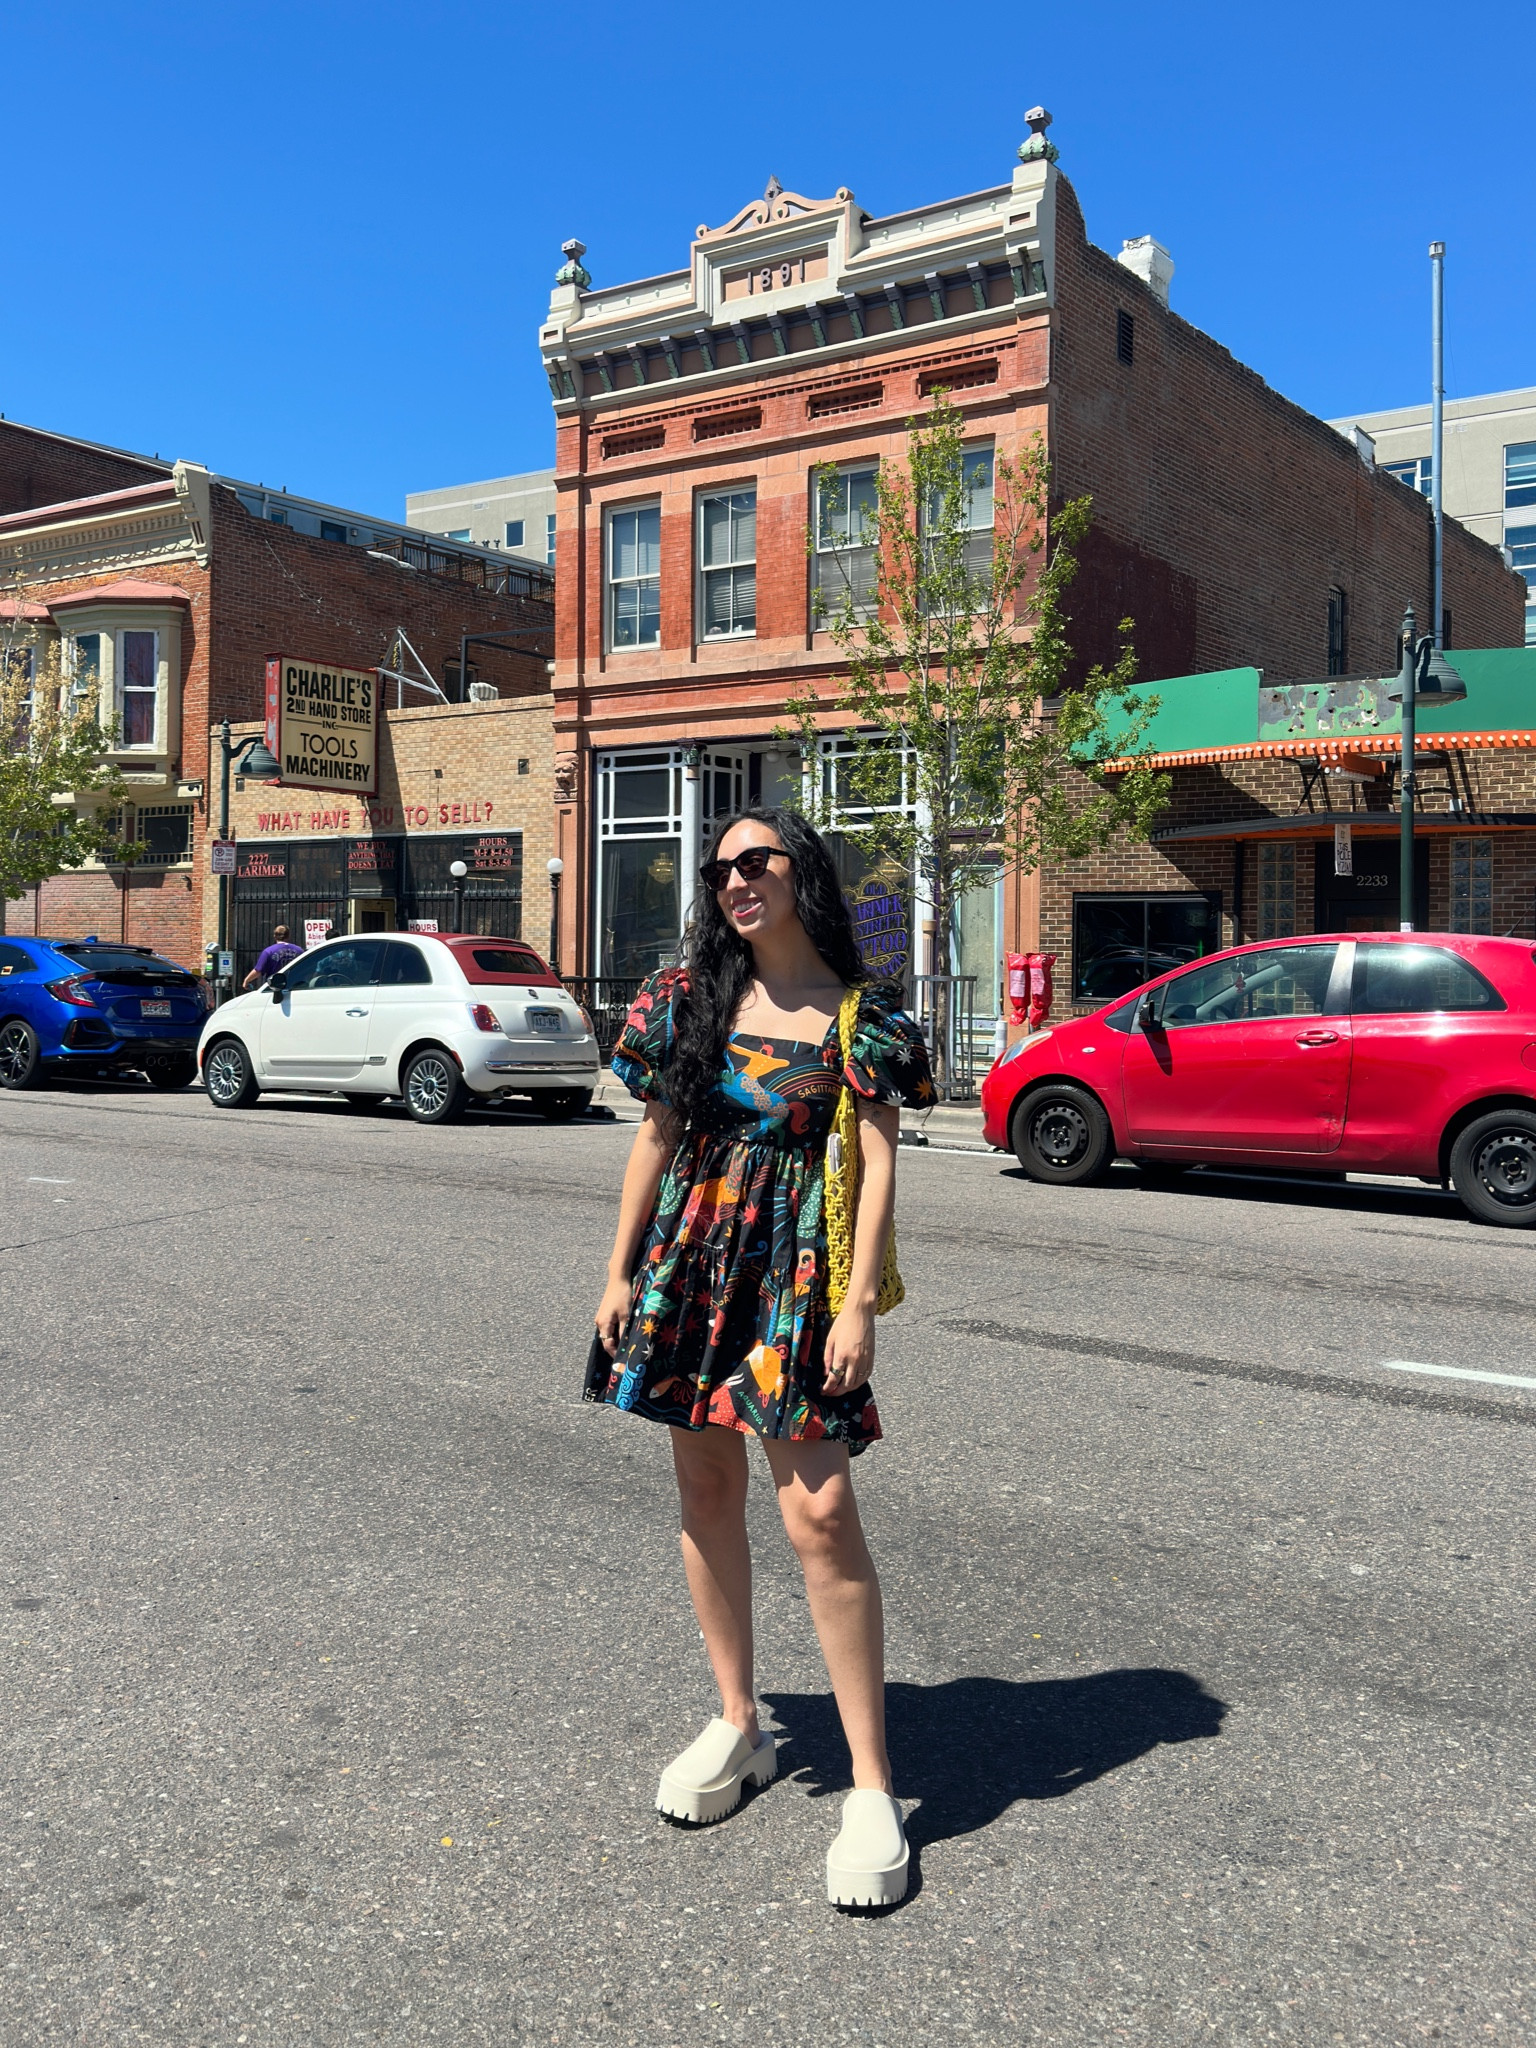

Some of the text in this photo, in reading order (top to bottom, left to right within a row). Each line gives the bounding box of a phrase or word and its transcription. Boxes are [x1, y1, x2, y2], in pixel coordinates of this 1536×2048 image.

[748, 258, 804, 292] 1891
[286, 667, 372, 707] CHARLIE'S
[286, 697, 371, 724] 2ND HAND STORE
[300, 733, 358, 759] TOOLS
[286, 755, 371, 782] MACHINERY
[258, 802, 494, 831] WHAT HAVE YOU TO SELL?
[356, 841, 387, 850] WE BUY
[479, 837, 507, 846] HOURS
[249, 852, 269, 865] 2227
[237, 864, 286, 877] LARIMER
[1356, 875, 1388, 887] 2233
[865, 883, 887, 895] OLD
[306, 922, 331, 932] OPEN
[410, 923, 437, 932] HOURS
[797, 1084, 841, 1099] SAGITTARI
[737, 1390, 764, 1425] AQUARIUS
